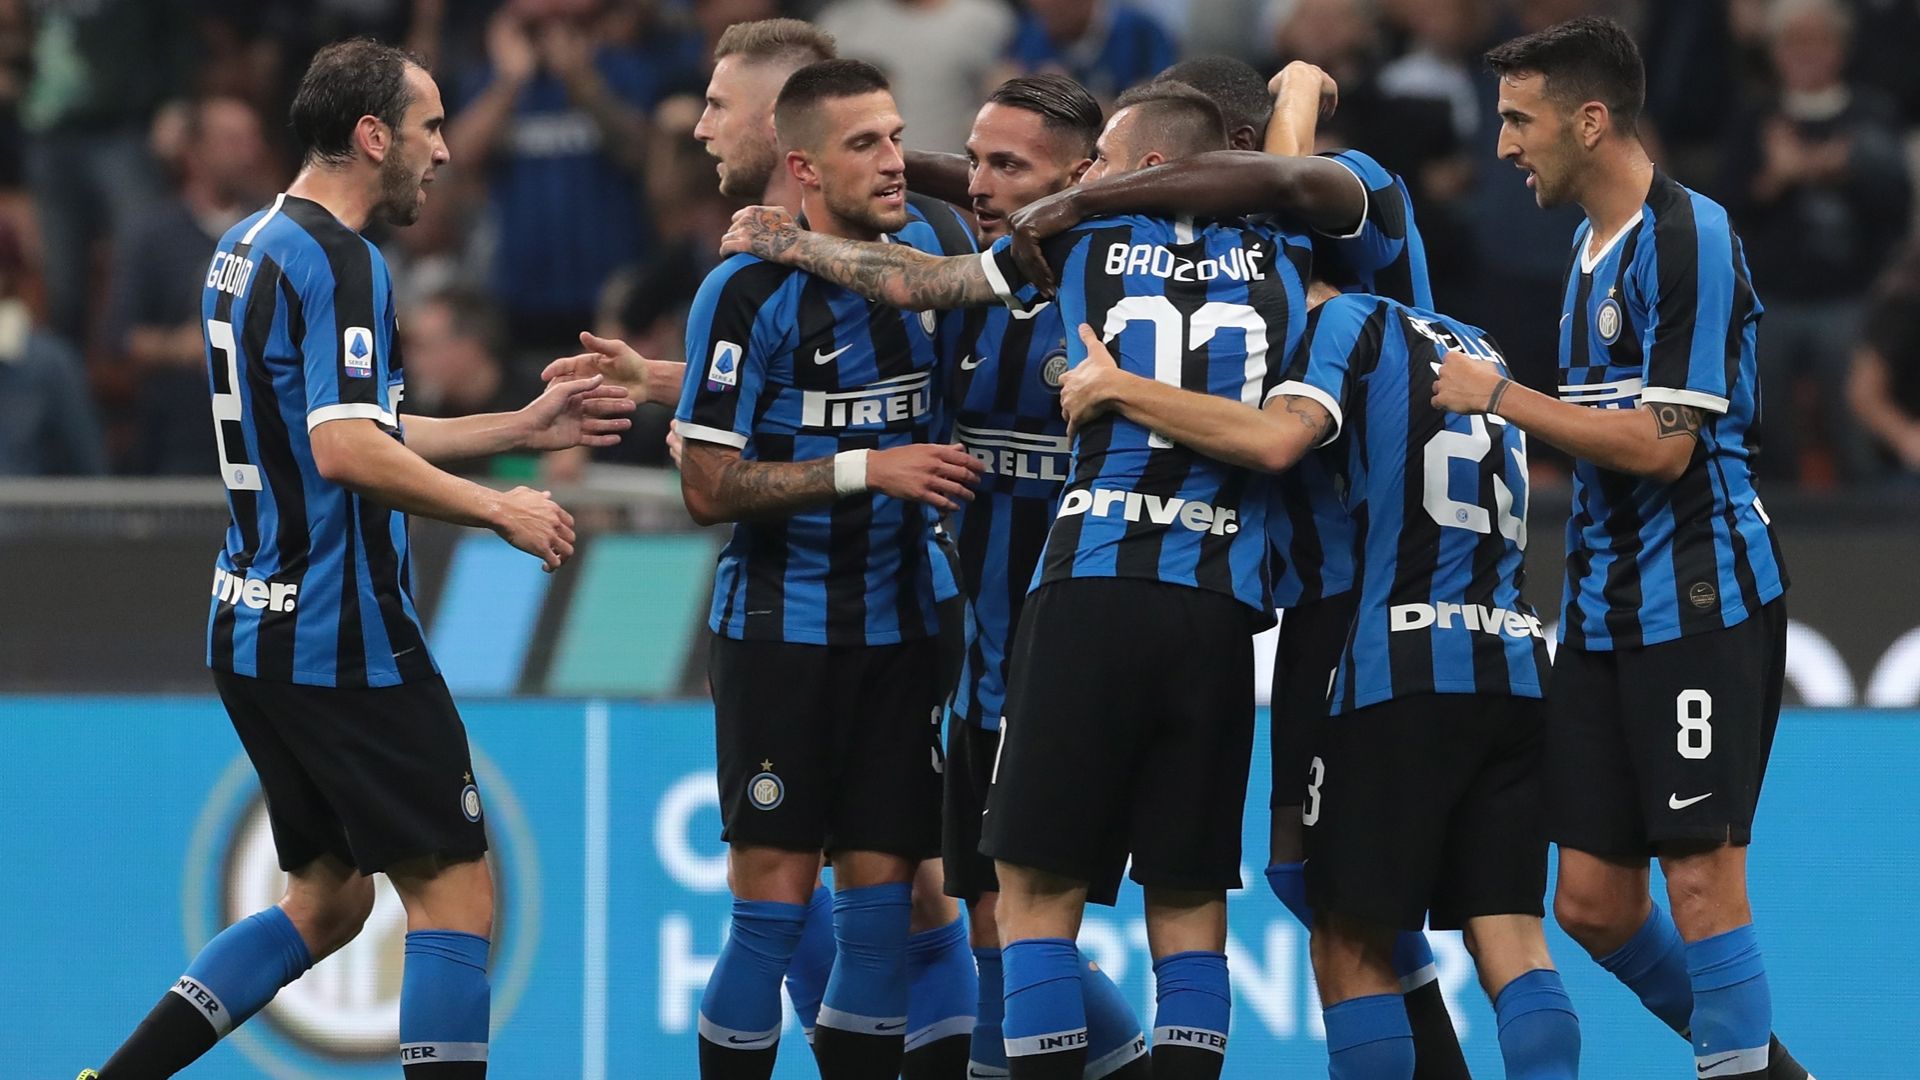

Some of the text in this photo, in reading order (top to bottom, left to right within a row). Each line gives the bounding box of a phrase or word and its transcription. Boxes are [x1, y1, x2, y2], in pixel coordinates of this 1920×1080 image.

[1105, 243, 1266, 282] BROZOVIĆ
[207, 319, 263, 491] 2
[1676, 688, 1713, 760] 8
